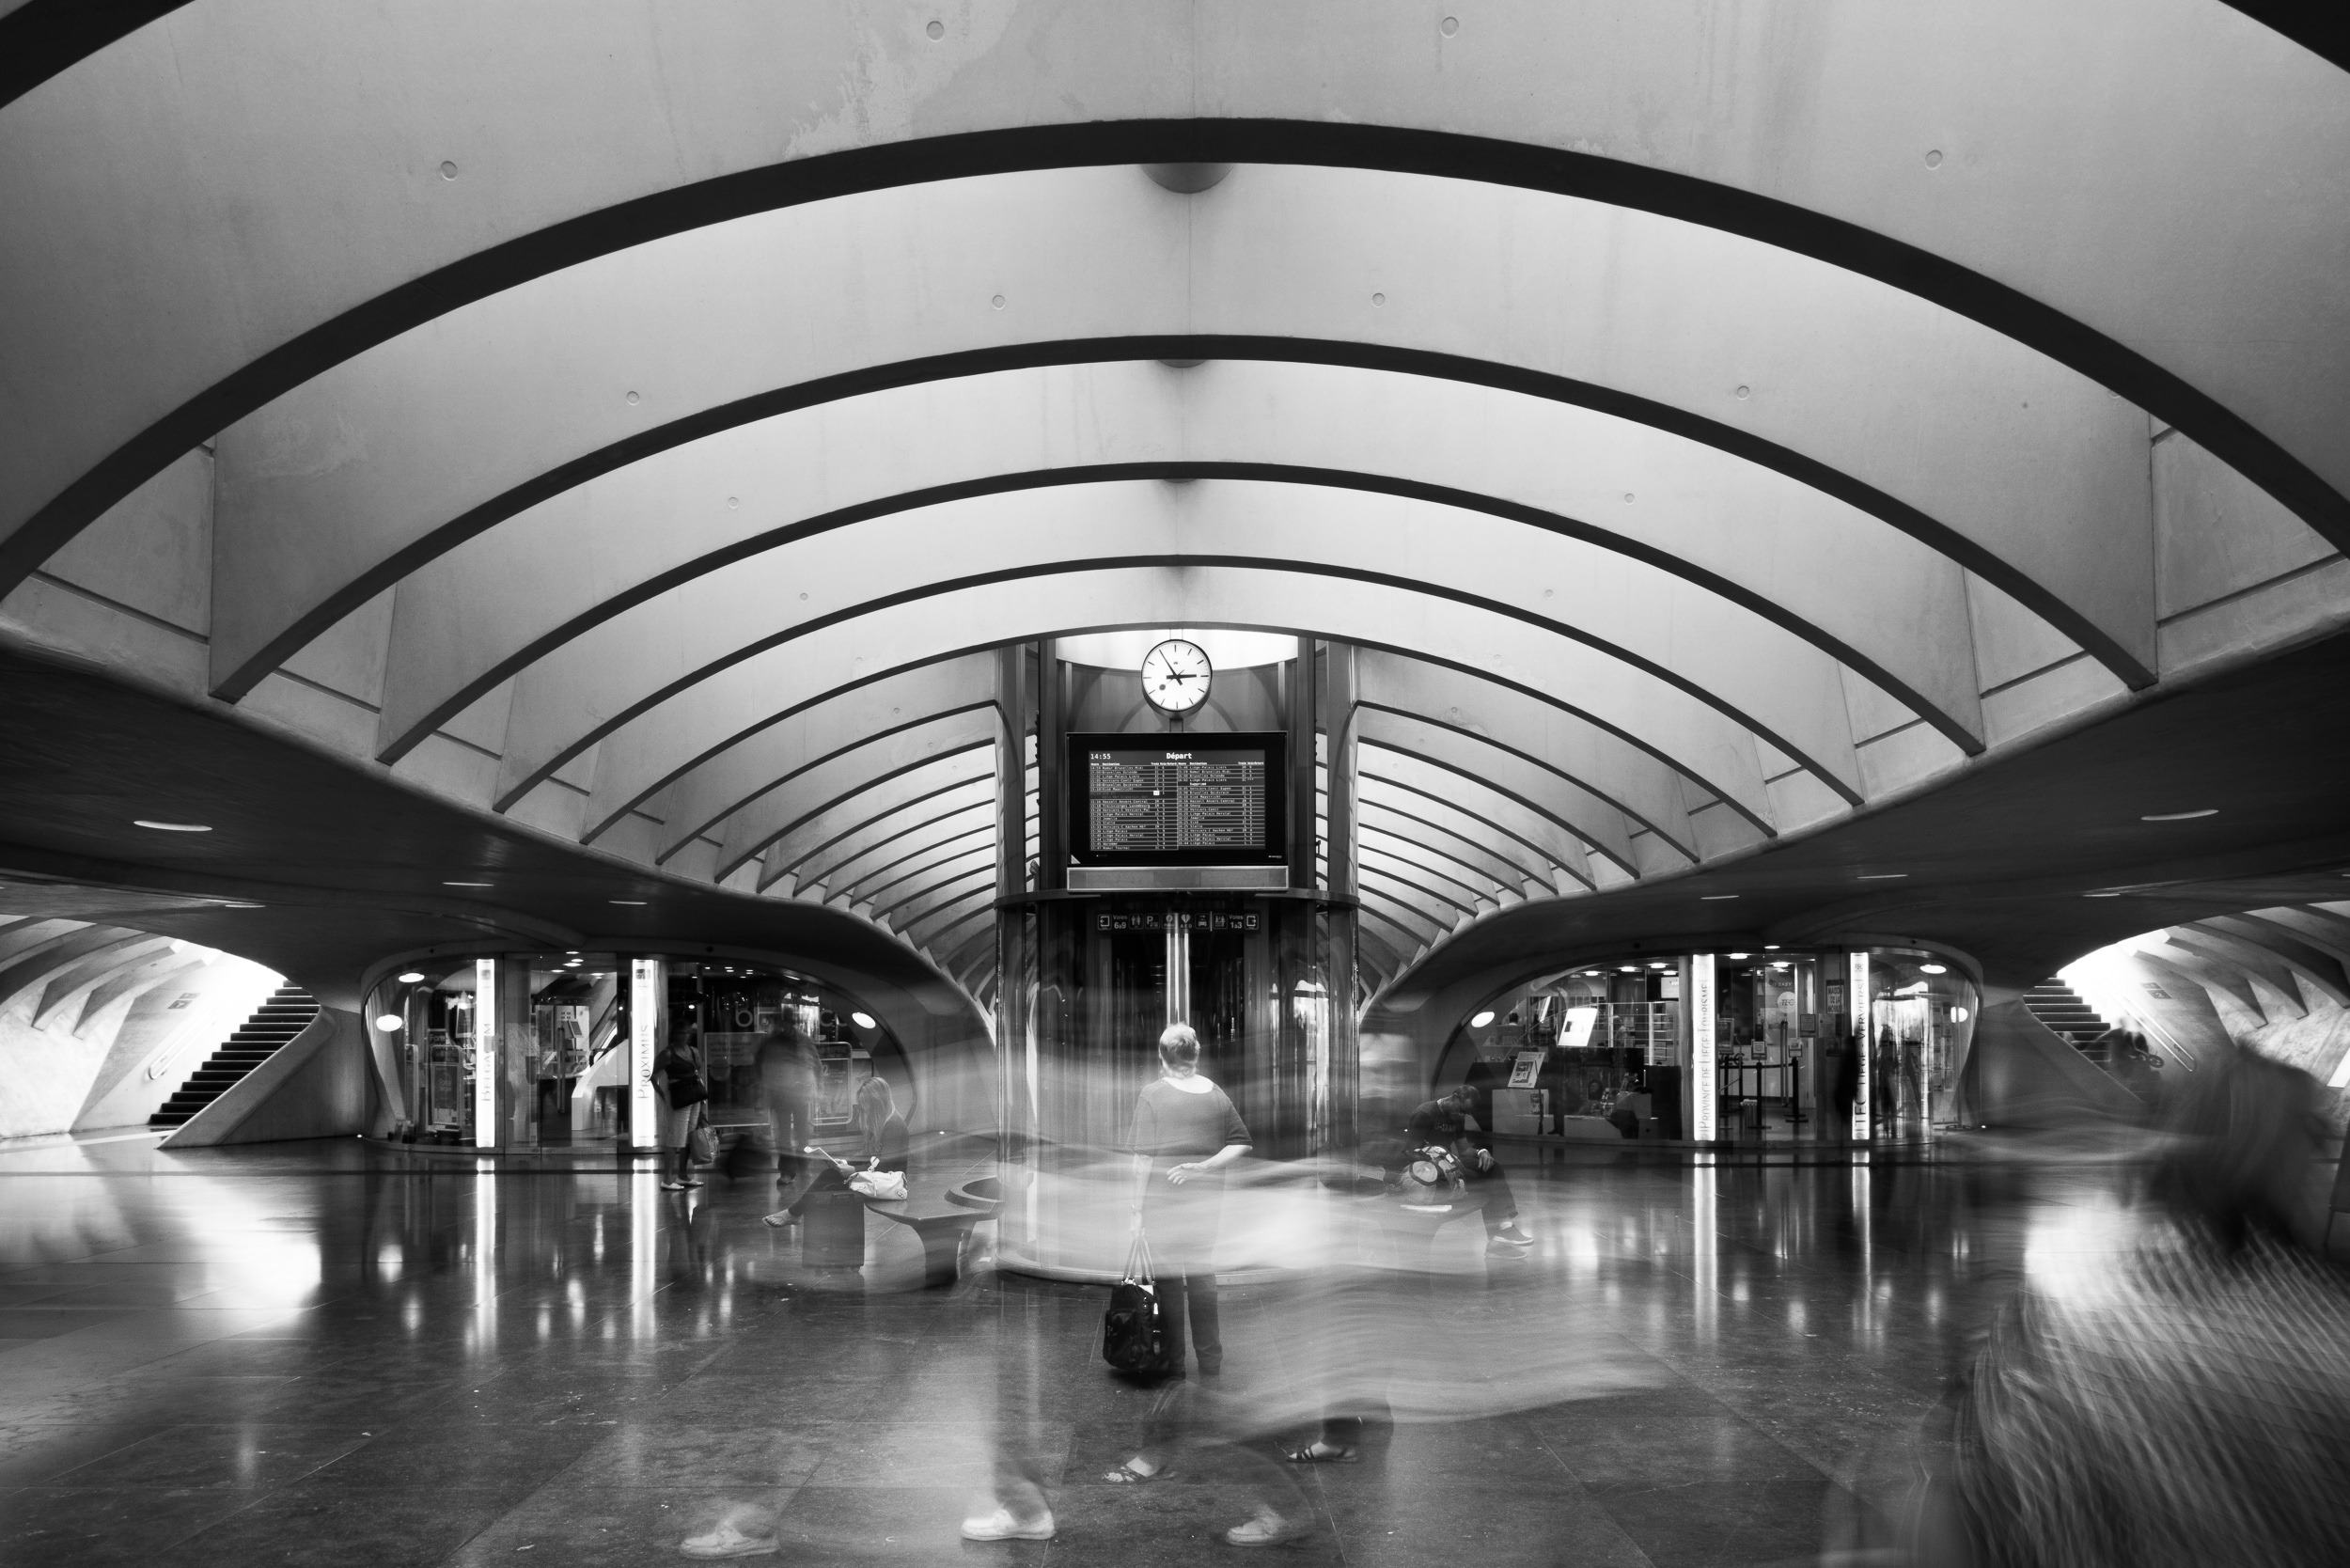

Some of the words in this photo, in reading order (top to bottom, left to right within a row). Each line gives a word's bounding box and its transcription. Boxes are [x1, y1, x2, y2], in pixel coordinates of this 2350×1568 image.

[1167, 752, 1192, 760] Départ
[1147, 916, 1153, 925] P
[1857, 982, 1866, 1039] VERVIERS
[636, 1025, 650, 1099] PROXIMUS
[1702, 1067, 1711, 1078] DE
[1699, 1082, 1712, 1129] PROVINCE
[1855, 1094, 1866, 1127] TEC
